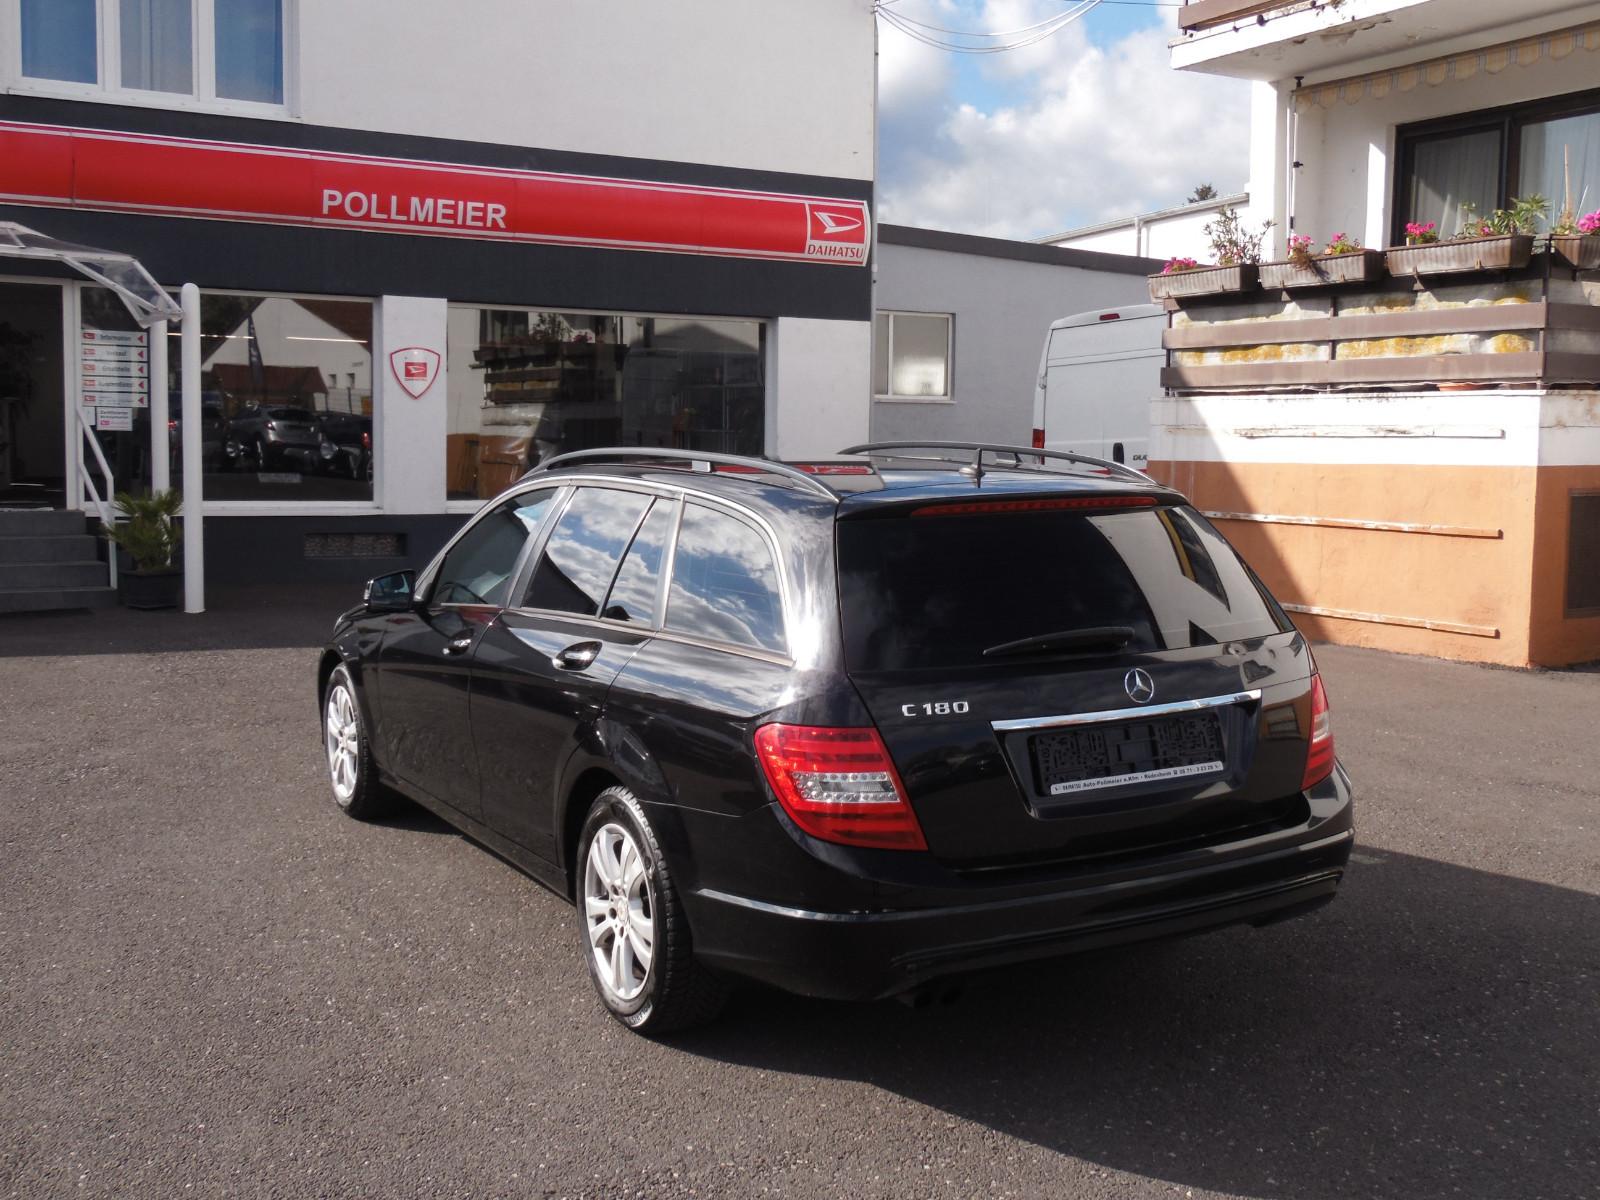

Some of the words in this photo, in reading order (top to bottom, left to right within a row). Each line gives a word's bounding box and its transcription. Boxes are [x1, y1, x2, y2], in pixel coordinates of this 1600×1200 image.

[322, 189, 507, 229] POLLMEIER
[807, 244, 864, 259] DAIHATSU
[901, 703, 917, 717] C
[922, 700, 969, 716] 180
